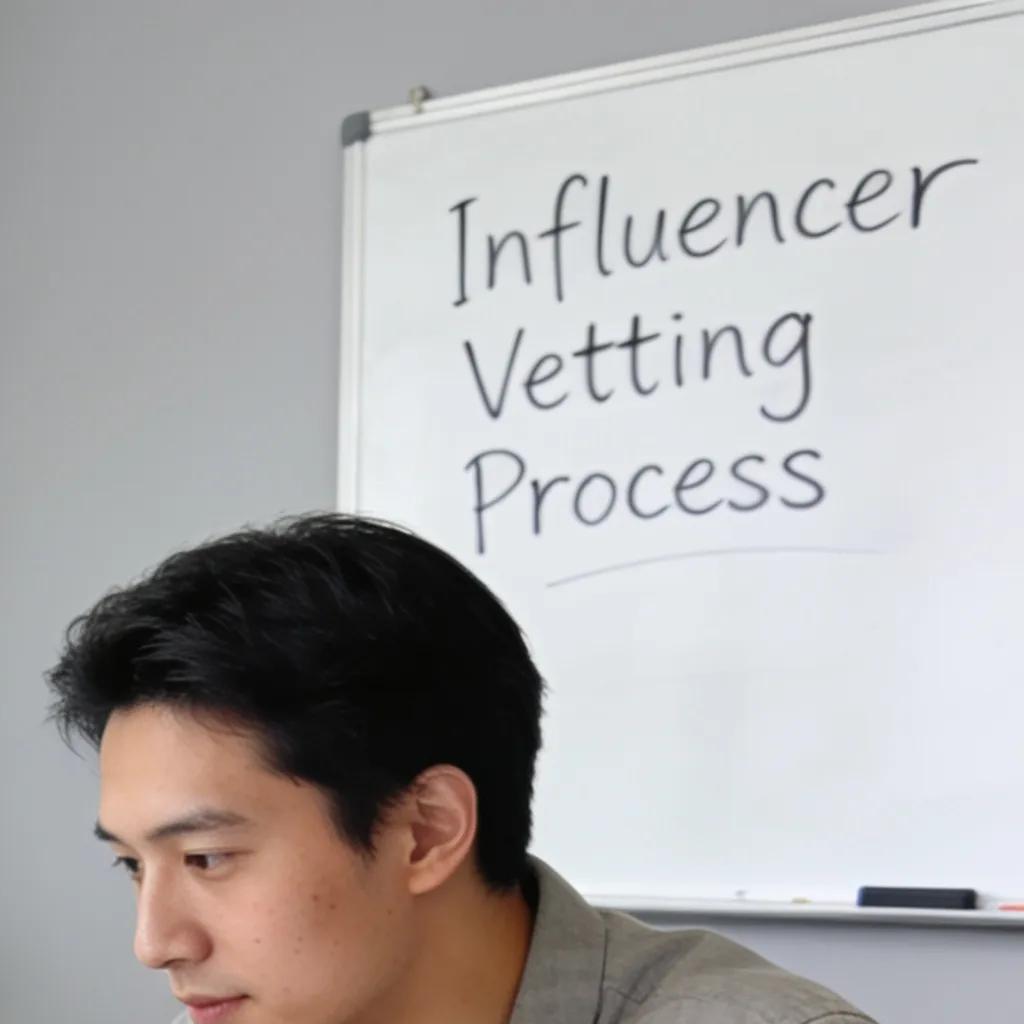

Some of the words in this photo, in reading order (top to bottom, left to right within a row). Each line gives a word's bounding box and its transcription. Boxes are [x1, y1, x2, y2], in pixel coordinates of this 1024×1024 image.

[450, 160, 978, 308] Influencer
[463, 312, 814, 423] Vetting
[465, 446, 827, 555] Process
